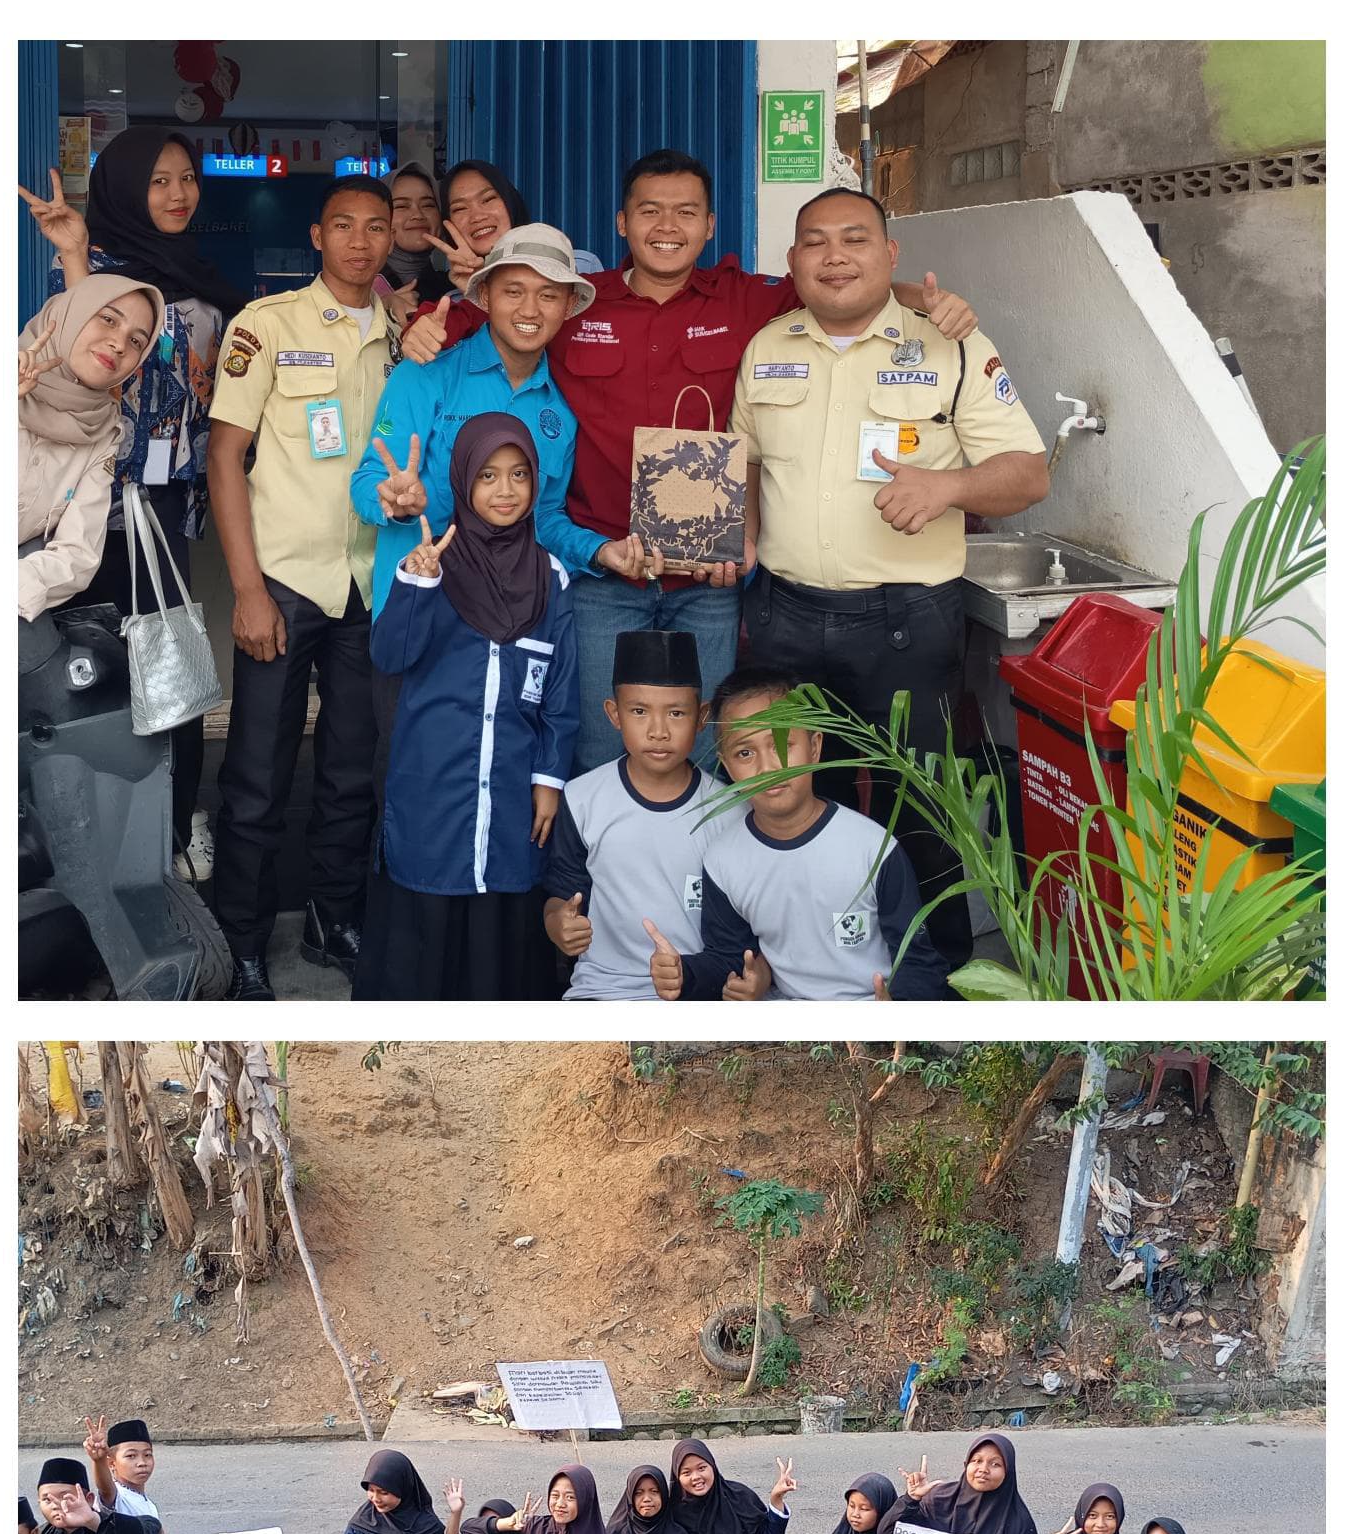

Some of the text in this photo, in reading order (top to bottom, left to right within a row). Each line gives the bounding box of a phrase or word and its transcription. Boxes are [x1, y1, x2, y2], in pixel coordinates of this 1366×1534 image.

[214, 159, 282, 173] TELLER 2
[881, 372, 936, 384] SATPAM
[1022, 750, 1071, 786] SAMPAH B3
[1027, 767, 1043, 782] TINTA
[1027, 790, 1047, 809] TONER
[1069, 792, 1087, 808] BEKA
